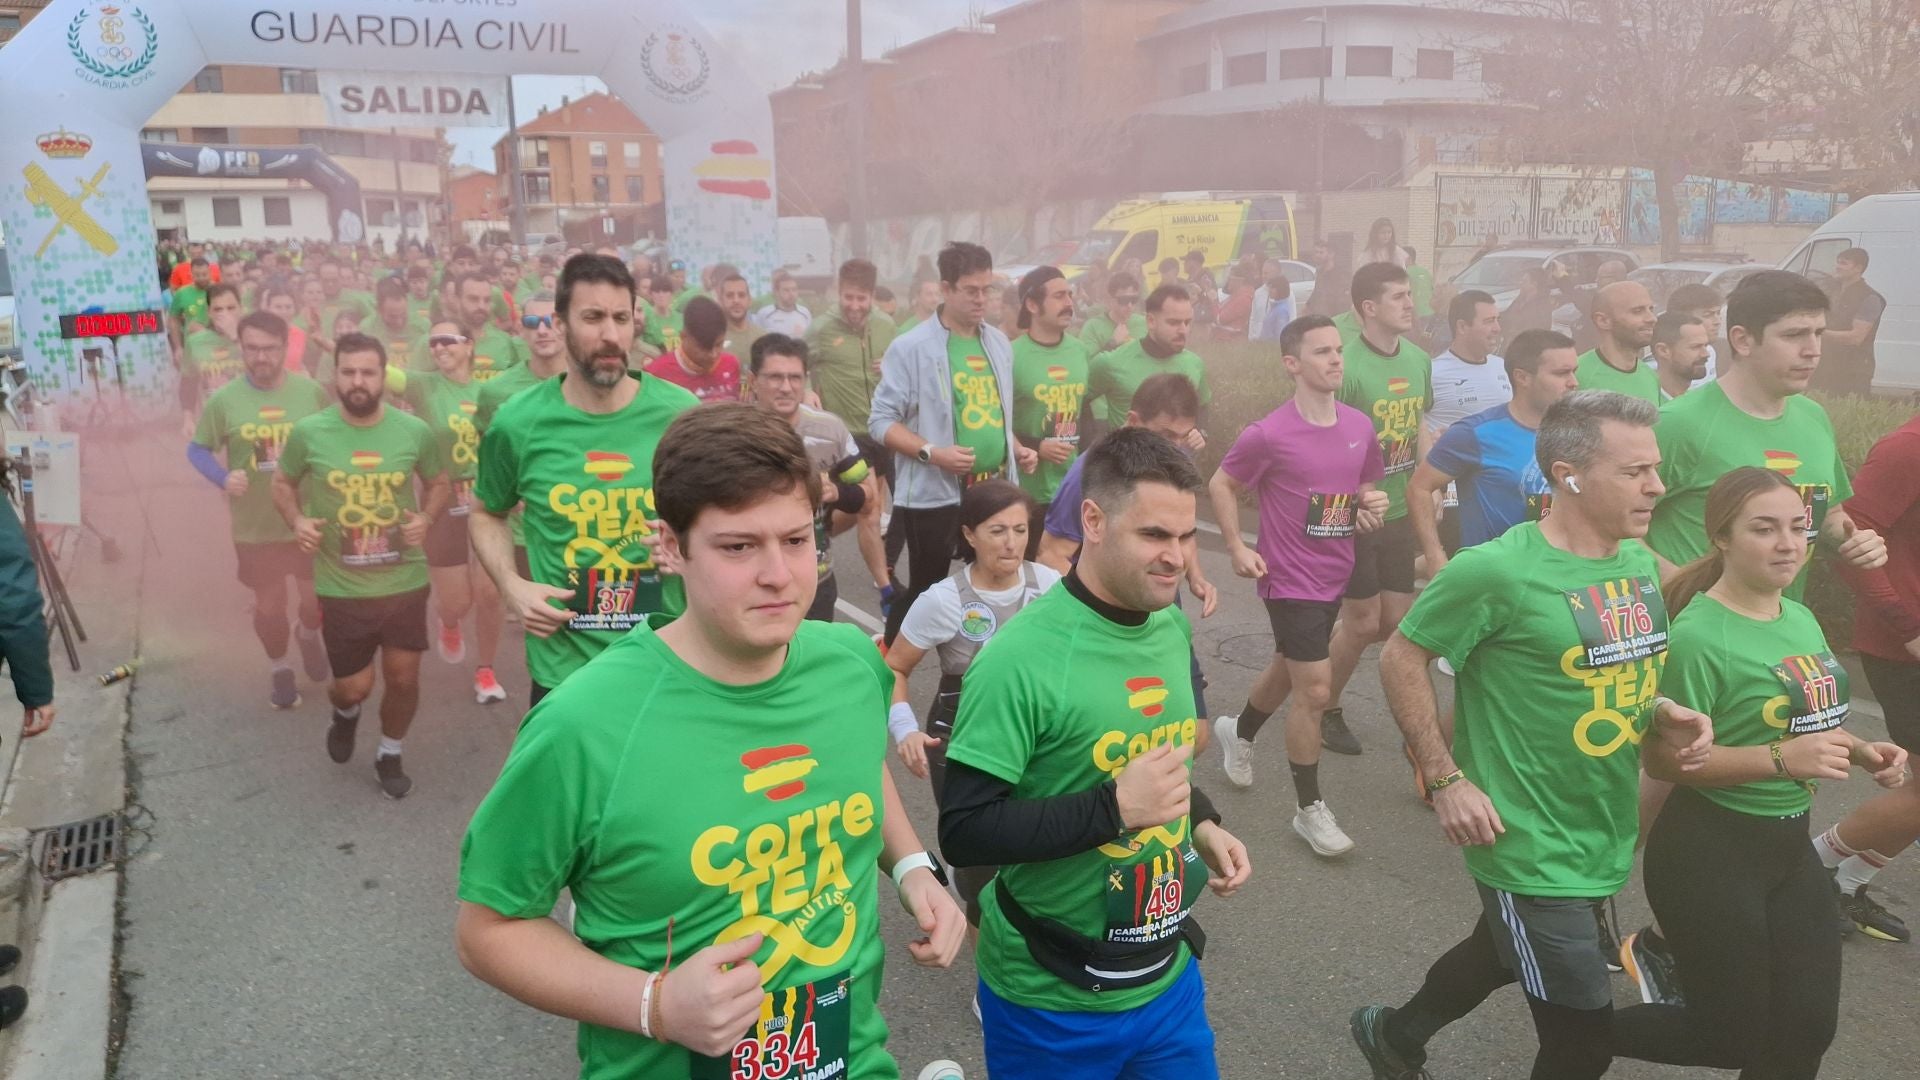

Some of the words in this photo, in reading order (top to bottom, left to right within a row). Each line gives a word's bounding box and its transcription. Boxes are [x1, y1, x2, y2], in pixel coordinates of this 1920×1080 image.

[250, 10, 463, 49] GUARDIA
[475, 20, 580, 54] CIVIL
[340, 85, 491, 115] SALIDA
[1171, 214, 1219, 224] AMBULANCIA
[1034, 383, 1085, 401] Corre
[1373, 397, 1424, 417] Corre
[328, 470, 405, 492] Corre
[568, 509, 651, 538] TEA
[1321, 508, 1351, 526] 235
[598, 588, 634, 614] 37
[1600, 602, 1653, 640] 176
[1593, 640, 1632, 655] CARRERA
[1595, 651, 1633, 665] GUARDIA
[1633, 646, 1652, 657] CIVIL
[1584, 669, 1656, 709] TEA
[1803, 675, 1838, 712] 177
[1795, 721, 1827, 732] GUARDIA
[1828, 717, 1840, 727] CIVIL
[1796, 710, 1827, 724] CARRERA
[1093, 718, 1196, 772] Corre
[690, 792, 874, 886] Corre
[728, 841, 852, 917] TEA
[1145, 880, 1182, 919] 49
[1113, 934, 1158, 942] GUARDIA
[1114, 922, 1160, 935] CARRERA
[763, 1016, 789, 1030] HUGO
[732, 1021, 820, 1080] 334
